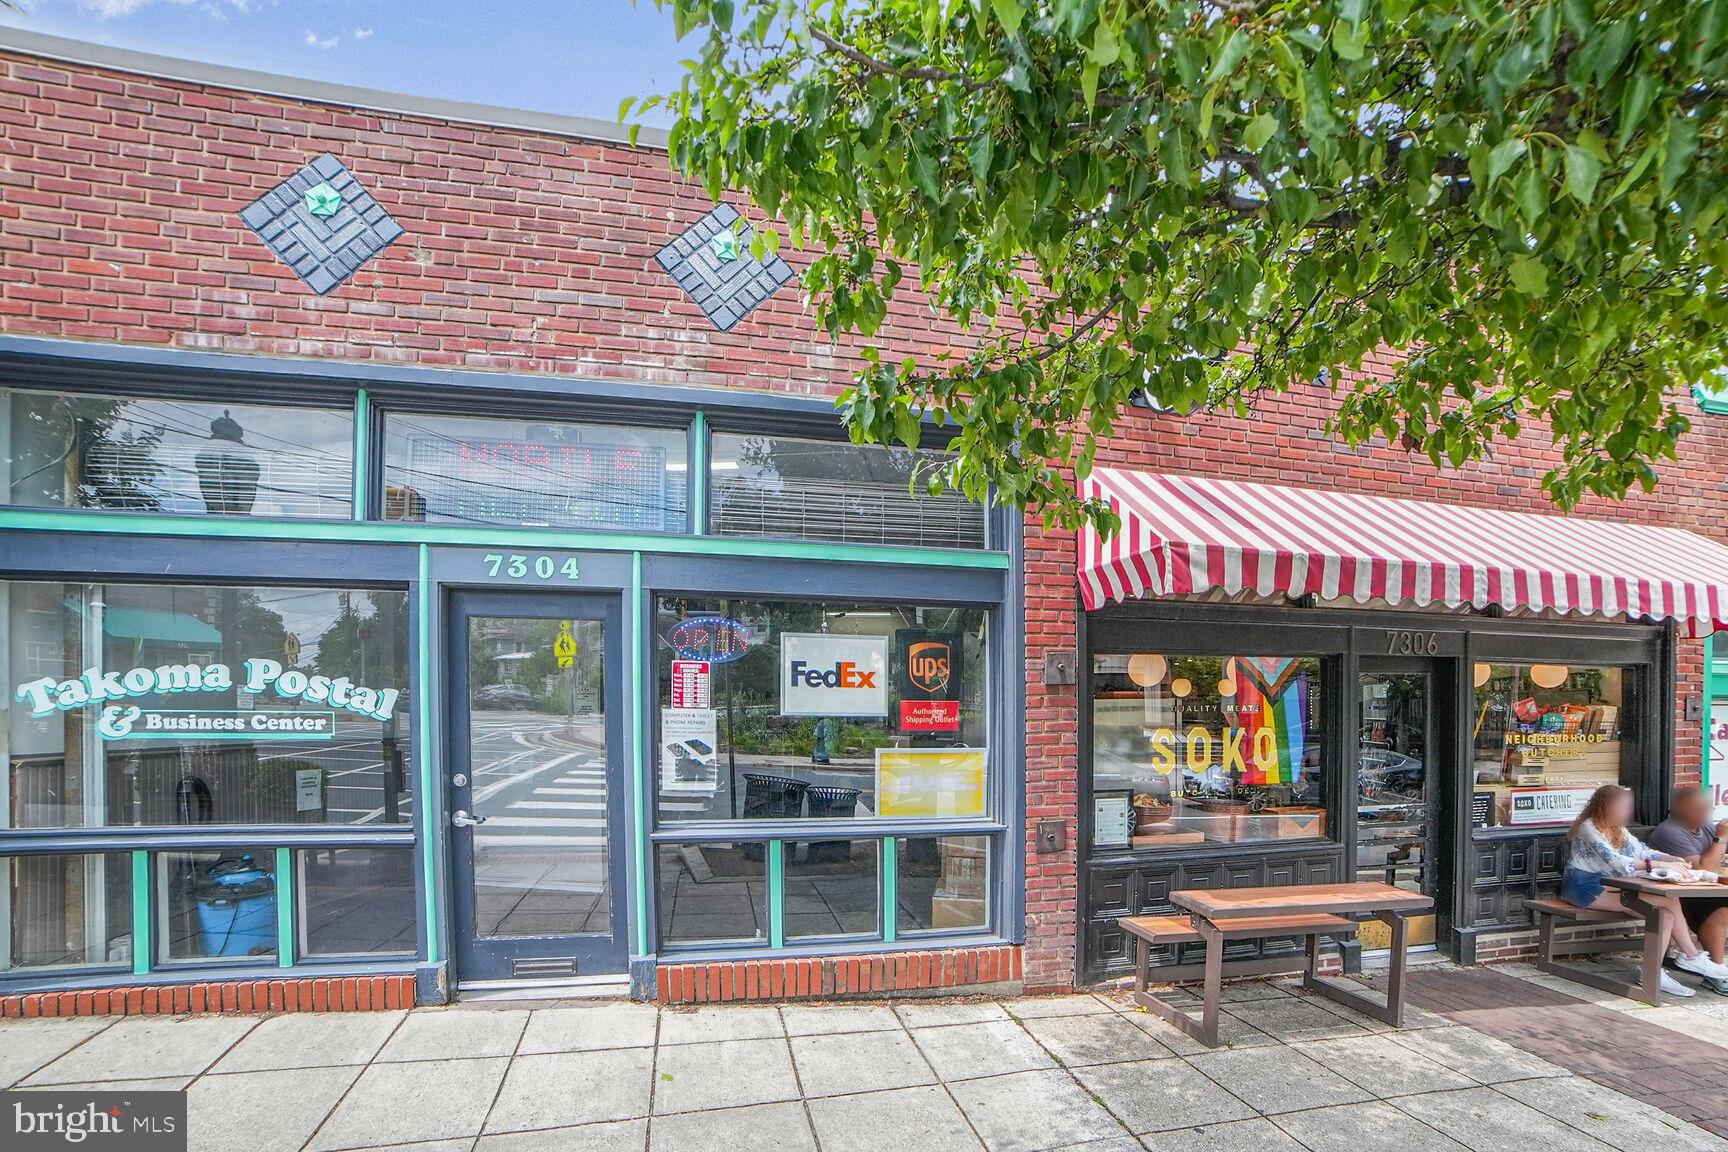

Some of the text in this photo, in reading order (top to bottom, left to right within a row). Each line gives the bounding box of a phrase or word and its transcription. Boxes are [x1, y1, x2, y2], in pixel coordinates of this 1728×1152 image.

[483, 554, 579, 580] 7304
[673, 628, 752, 653] OPEN
[1386, 631, 1438, 655] 7306
[791, 660, 877, 689] FedEx
[912, 656, 948, 684] ups
[16, 658, 399, 721] Takoma Postal
[905, 715, 933, 724] Shipping
[1170, 704, 1261, 713] QUALITY MEATS
[96, 706, 327, 739] & Business Center
[1150, 726, 1279, 776] SOKO
[1505, 734, 1604, 745] NEIGHBORHOOD
[1536, 795, 1571, 810] CATERING
